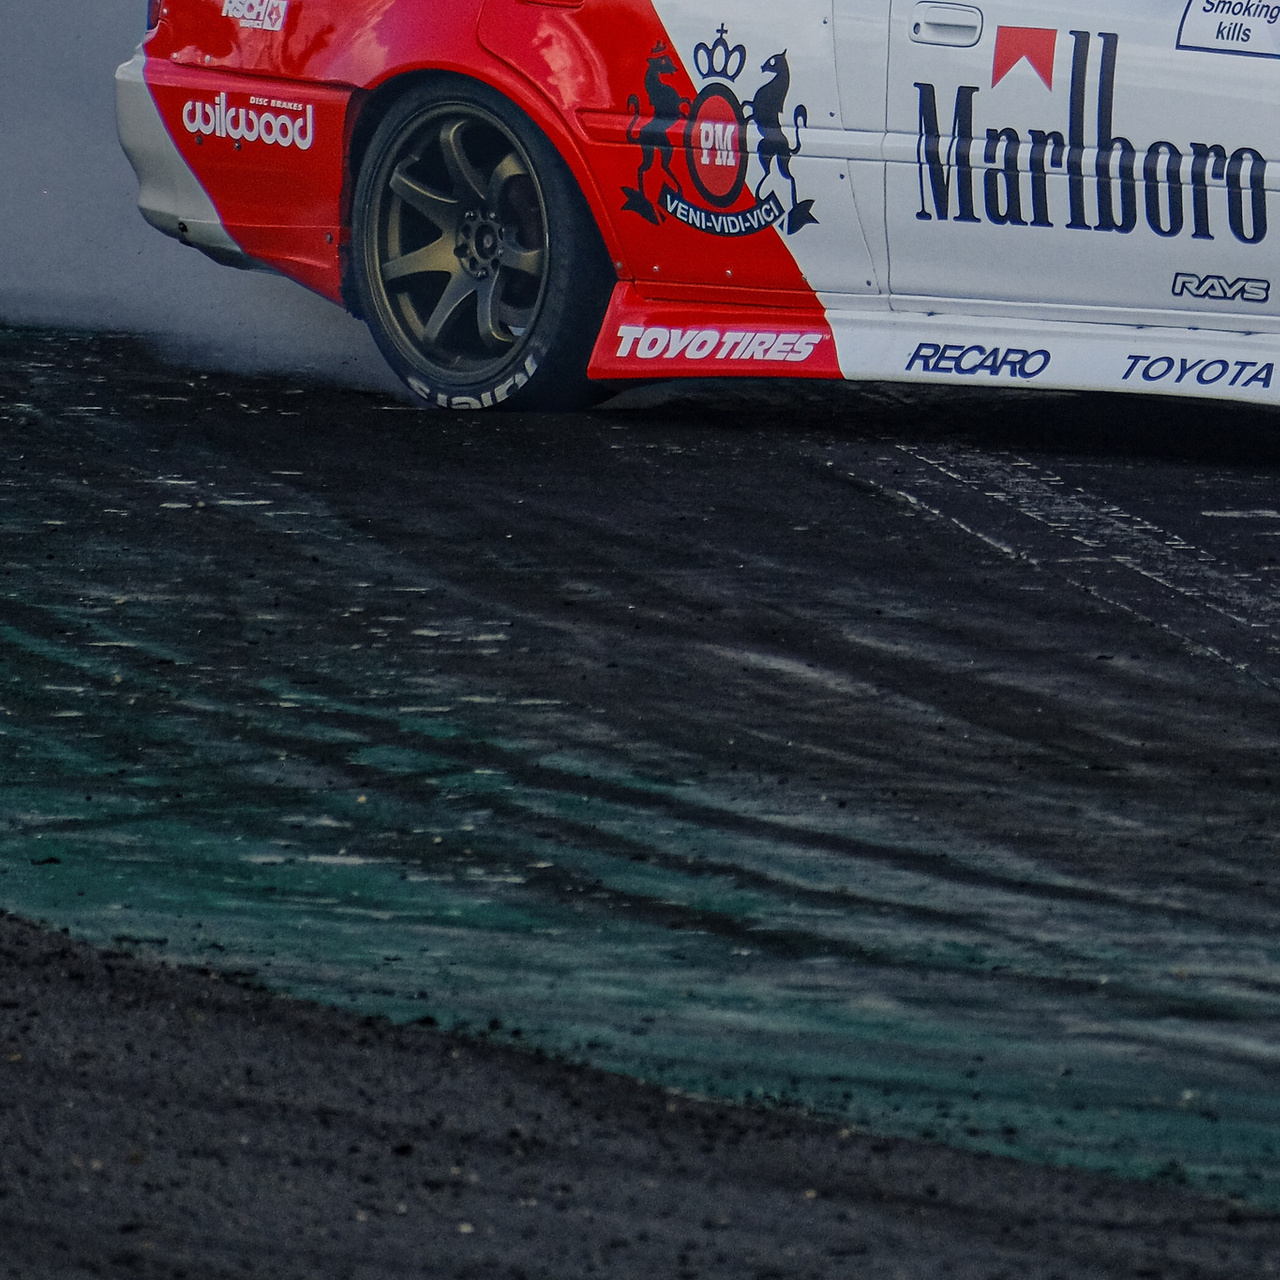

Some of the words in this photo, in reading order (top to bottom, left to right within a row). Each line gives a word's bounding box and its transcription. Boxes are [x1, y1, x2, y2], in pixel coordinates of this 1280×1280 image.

[1215, 21, 1252, 42] kills
[182, 92, 313, 150] wilwood
[249, 96, 269, 106] DISC
[270, 100, 303, 111] BRAKES
[700, 122, 736, 166] PM
[914, 30, 1267, 244] Marlboro
[666, 194, 779, 233] VENI-VIDI-VICI
[1172, 273, 1270, 302] RAYS
[616, 326, 720, 359] TOYO
[715, 332, 822, 362] TIRES
[905, 343, 1051, 379] RECARO
[1122, 354, 1276, 388] TOYOTA
